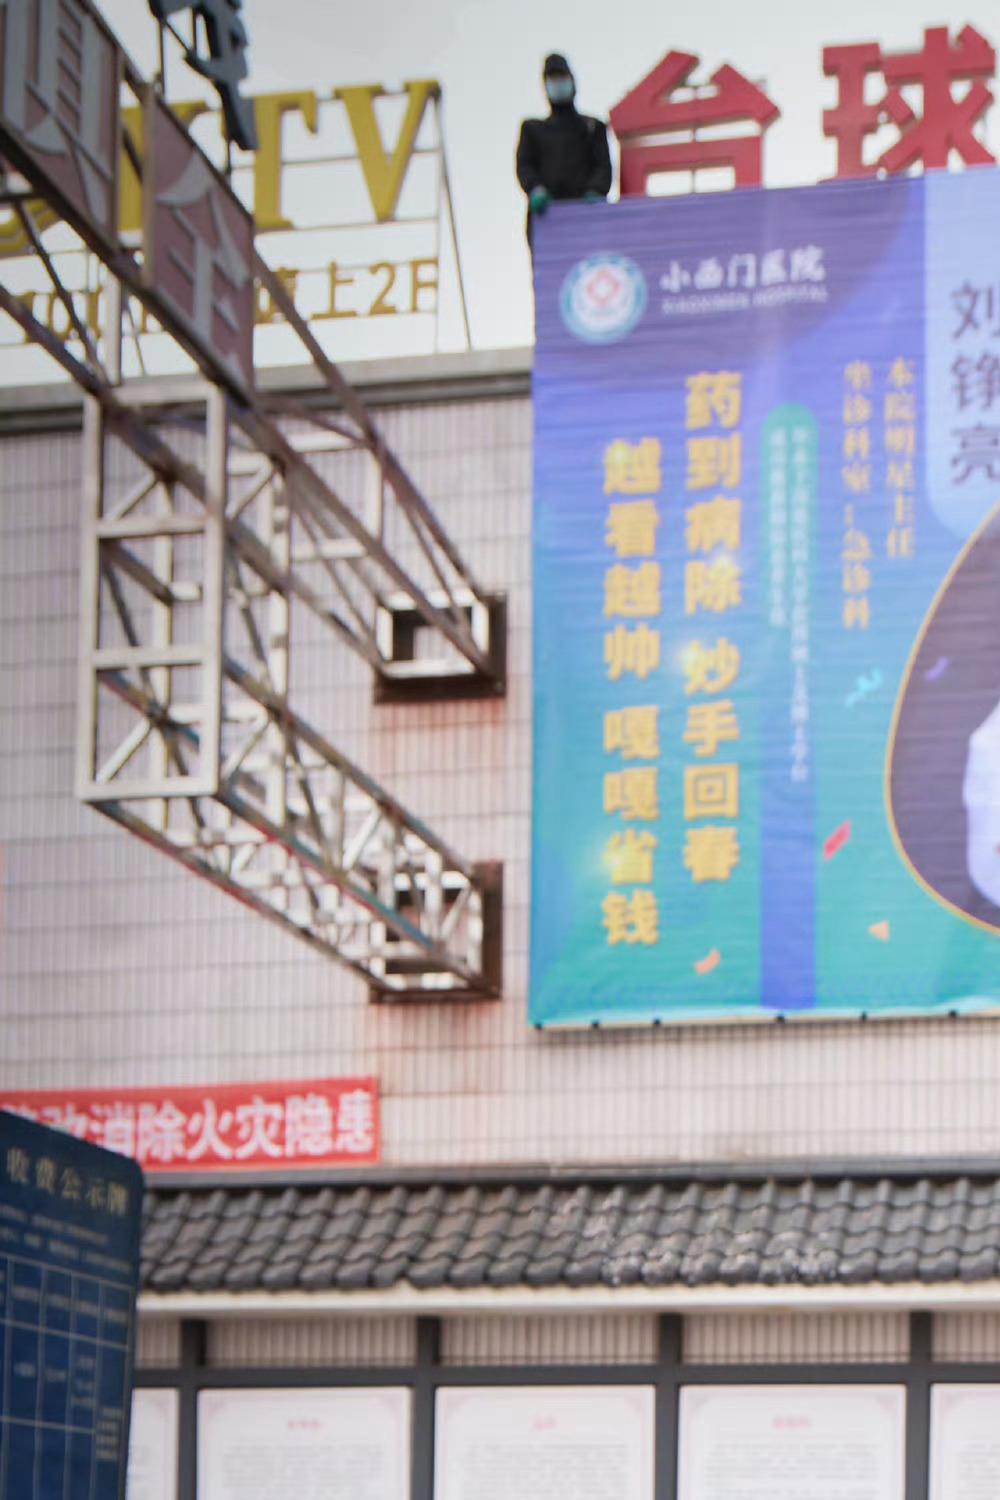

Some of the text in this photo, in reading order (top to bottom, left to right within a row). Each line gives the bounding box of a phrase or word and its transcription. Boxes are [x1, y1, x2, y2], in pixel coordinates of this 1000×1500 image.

[609, 24, 996, 198] 台球
[602, 437, 662, 945] 越看越帅 嘎嘎省钱
[683, 371, 742, 884] 药到病除 妙手回春
[2, 1087, 374, 1163] 消除火灾隐患
